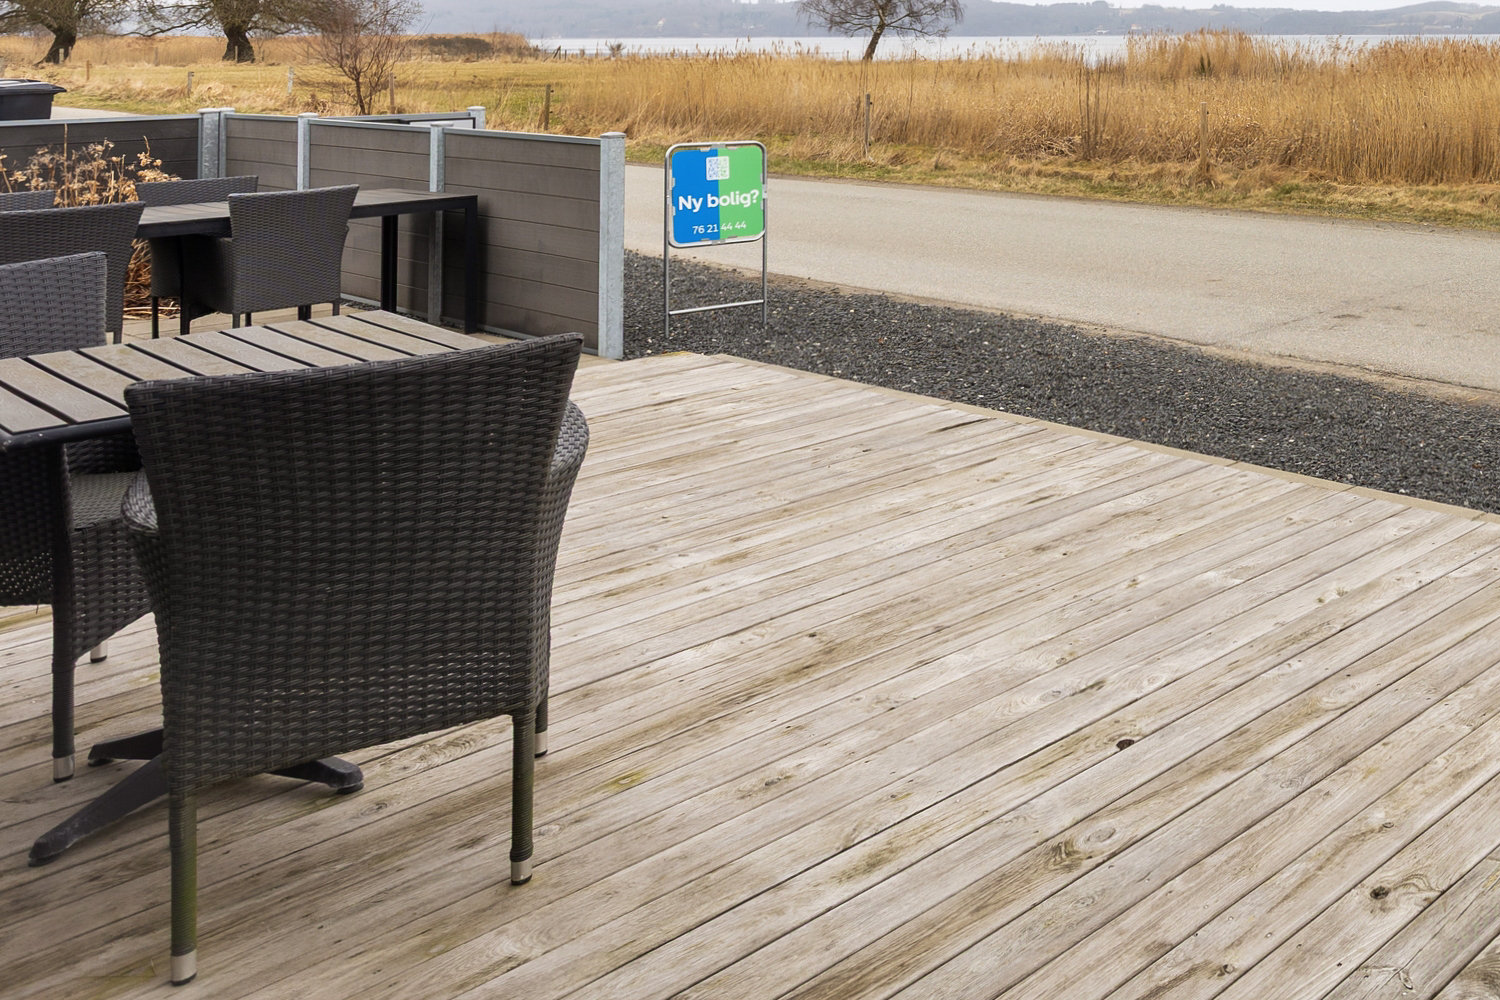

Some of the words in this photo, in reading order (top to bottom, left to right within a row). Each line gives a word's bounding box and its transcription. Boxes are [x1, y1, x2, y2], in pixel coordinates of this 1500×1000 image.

[678, 195, 703, 213] Ny
[707, 189, 759, 208] bolig?
[692, 225, 704, 234] 76
[706, 224, 718, 233] 21
[720, 222, 733, 231] 44
[735, 221, 746, 229] 44
